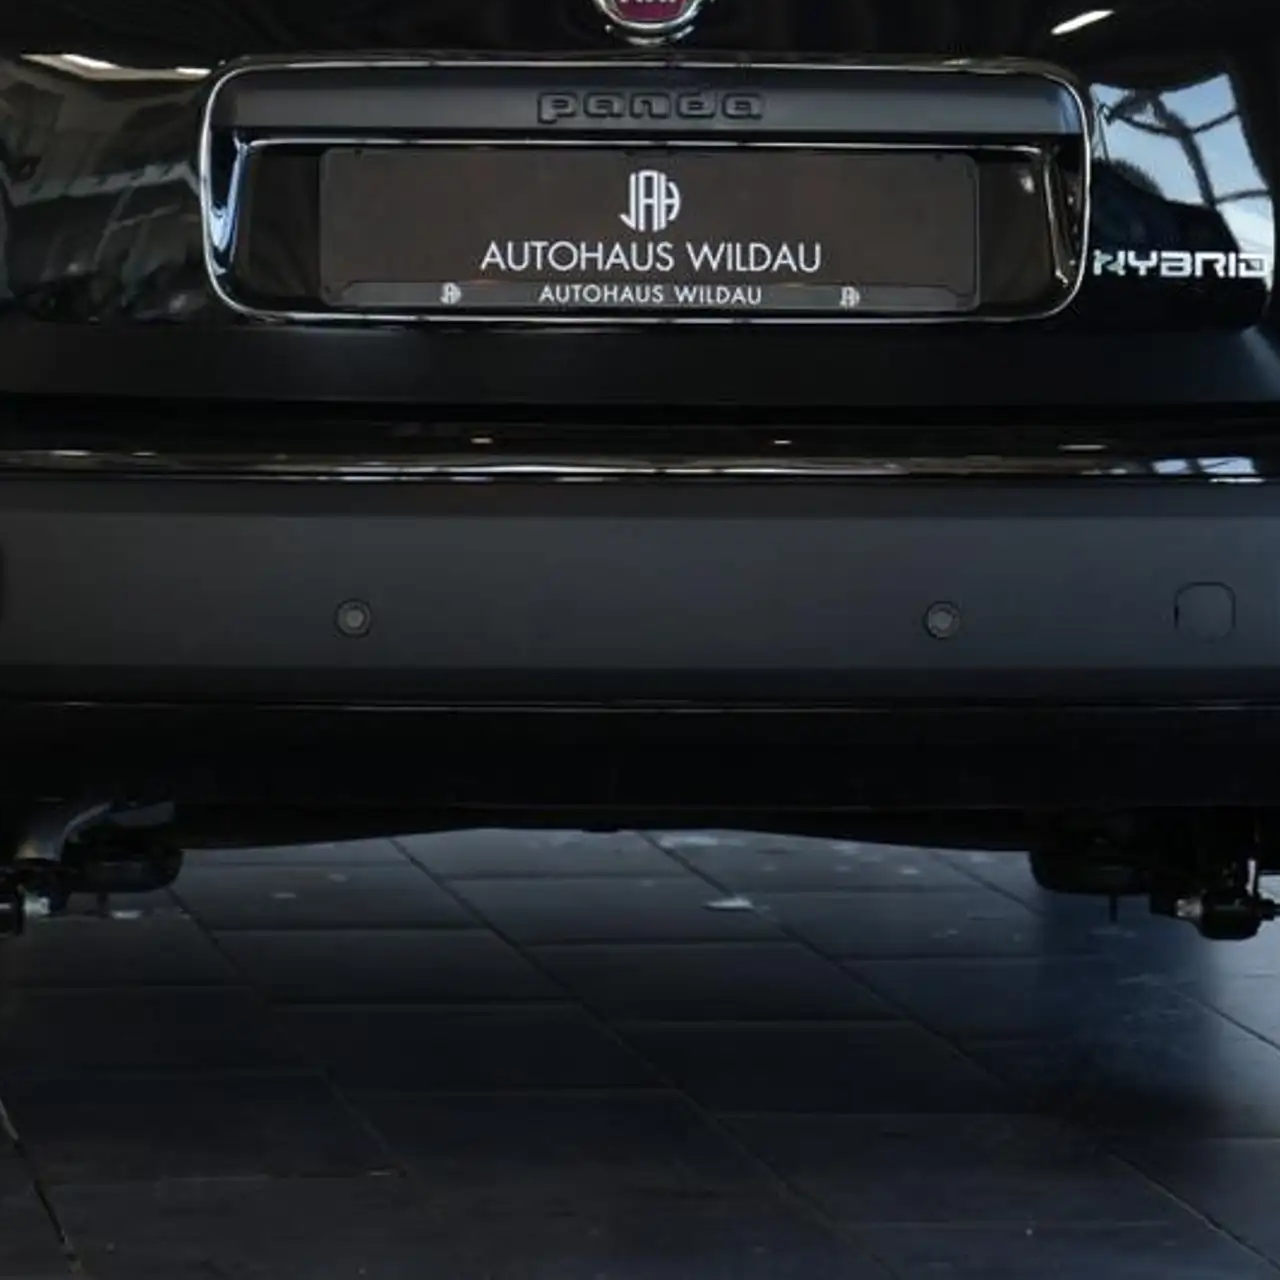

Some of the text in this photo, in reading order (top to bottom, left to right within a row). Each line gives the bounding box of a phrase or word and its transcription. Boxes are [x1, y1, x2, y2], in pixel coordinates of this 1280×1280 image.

[536, 91, 763, 124] panda
[480, 241, 822, 273] AUTOHAUS WILDAU
[1093, 249, 1269, 278] HYBRID
[538, 284, 763, 305] AUTOHAUS WILDAU
